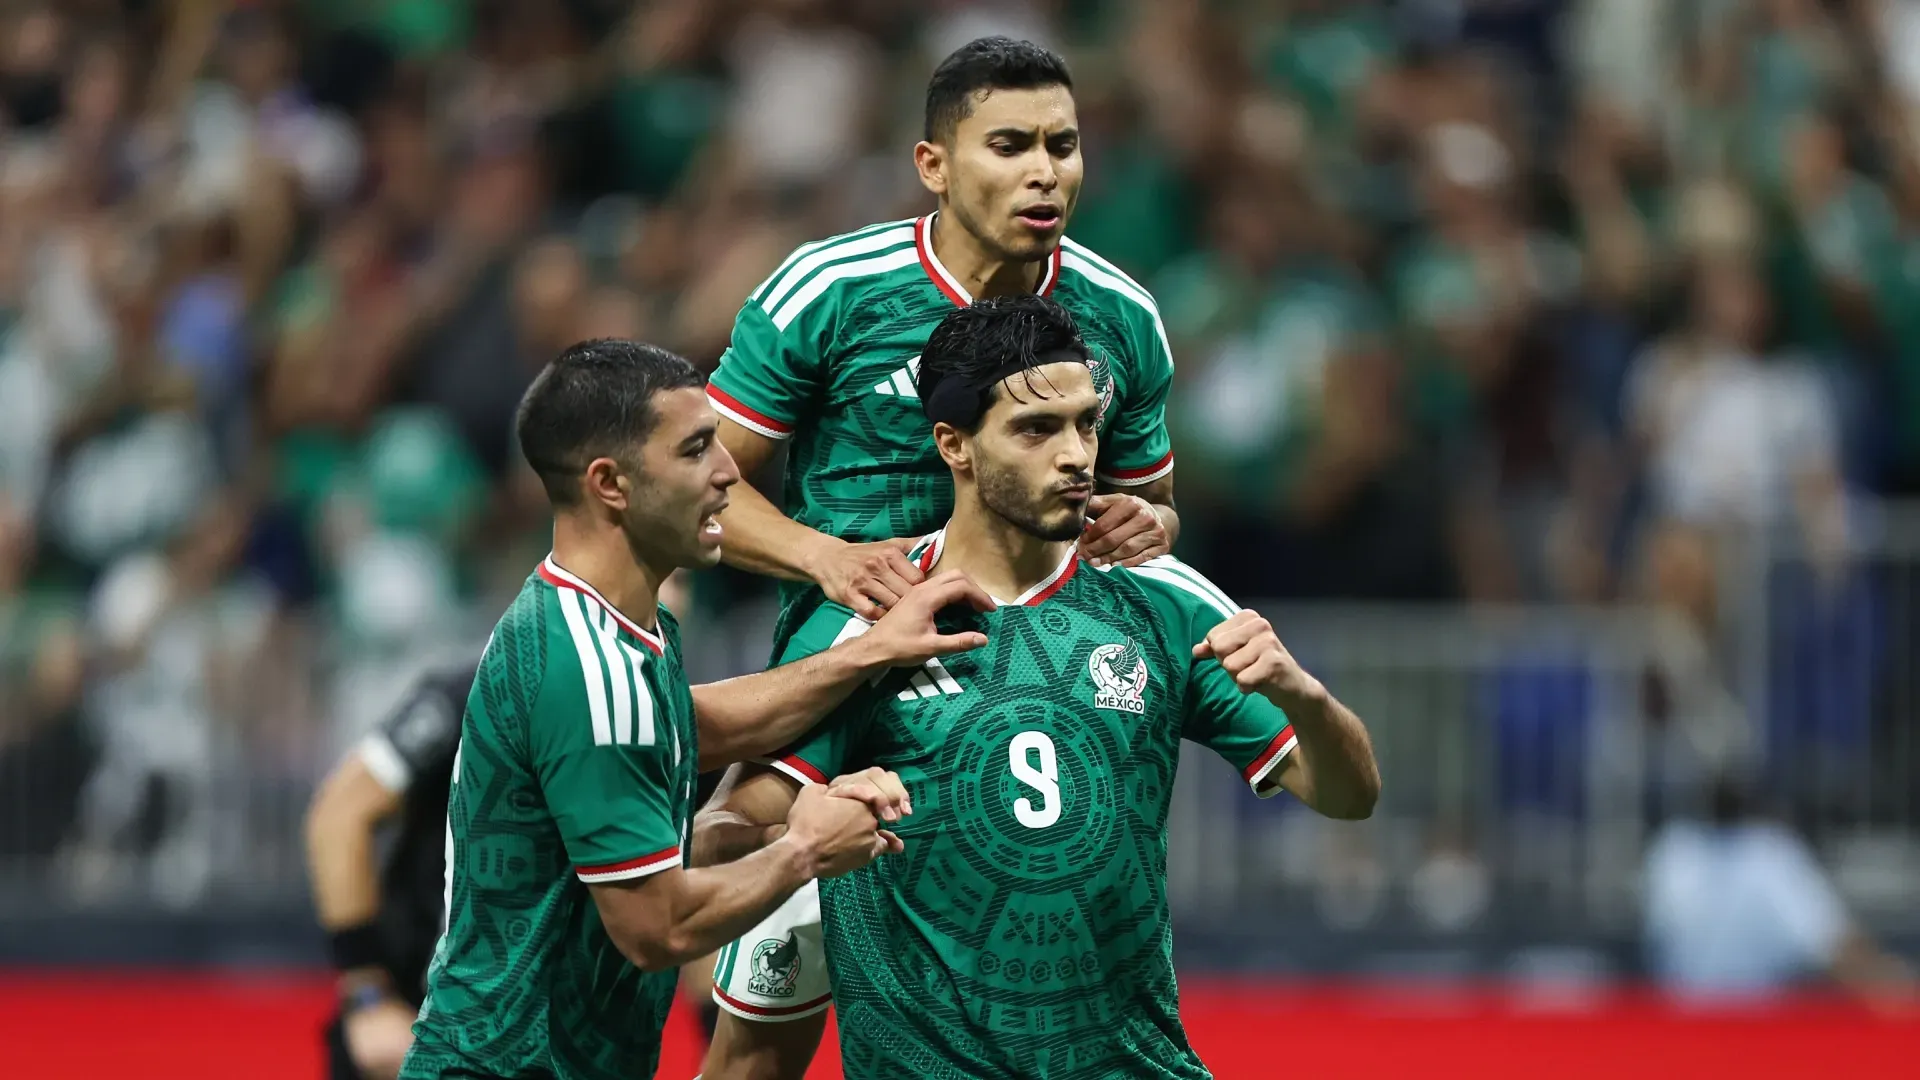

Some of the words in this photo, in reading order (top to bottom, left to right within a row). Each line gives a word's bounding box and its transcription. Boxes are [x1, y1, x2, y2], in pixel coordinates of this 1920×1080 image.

[1096, 695, 1143, 711] MÉXICO
[1008, 730, 1062, 829] 9
[750, 983, 793, 995] MÉXICO
